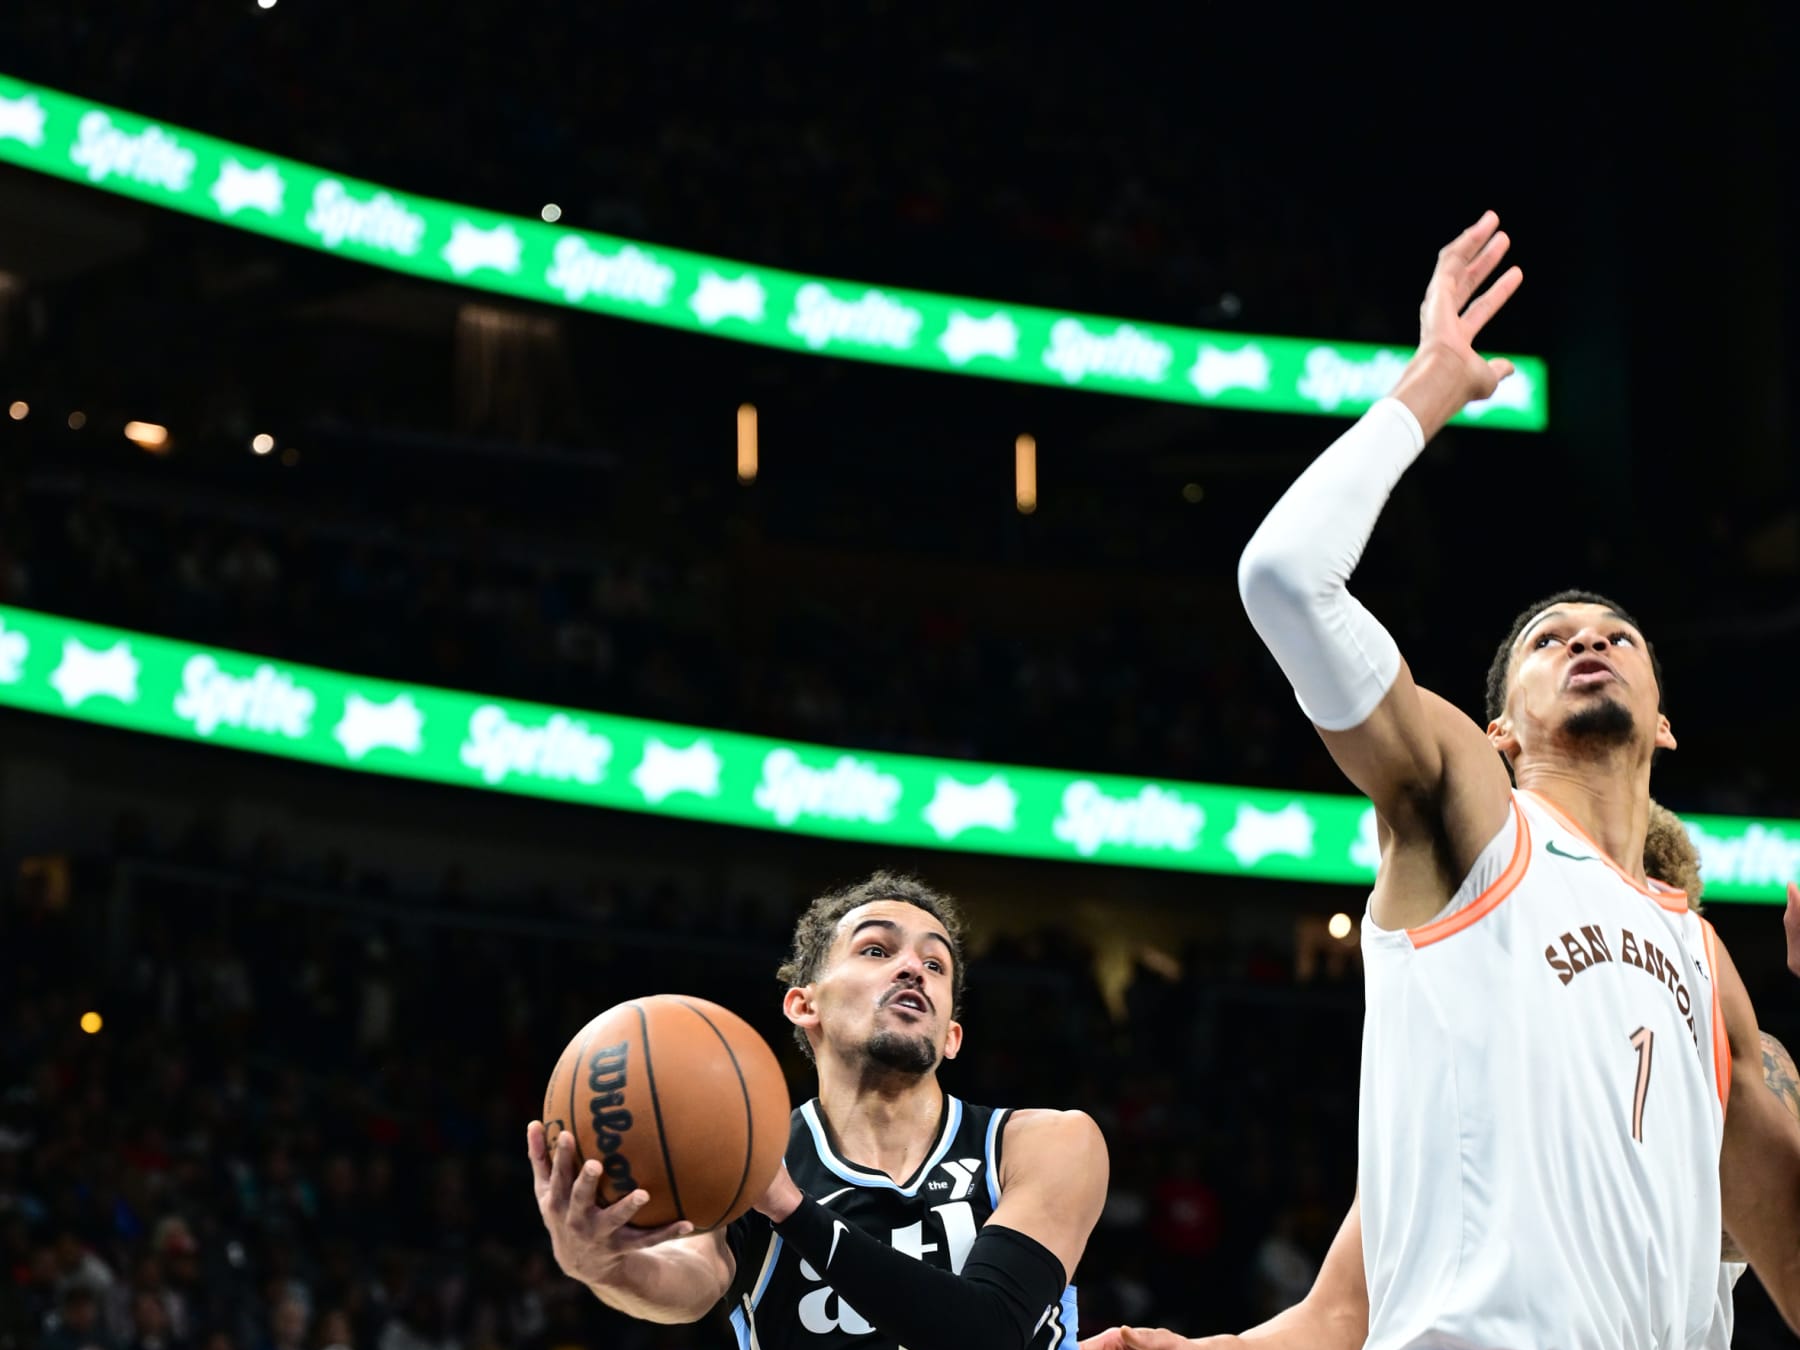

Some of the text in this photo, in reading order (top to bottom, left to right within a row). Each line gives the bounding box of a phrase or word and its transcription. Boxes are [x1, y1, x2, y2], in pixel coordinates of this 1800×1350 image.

[70, 111, 196, 191] Sprite
[305, 179, 425, 255] Sprite
[546, 235, 675, 306] Sprite
[786, 283, 922, 349] Sprite
[1042, 319, 1173, 383] Sprite
[1298, 346, 1408, 410] Spri
[173, 655, 316, 738] Sprite
[460, 705, 612, 784] Sprite
[753, 748, 902, 825] Sprite
[1053, 780, 1205, 856] Sprite
[1545, 924, 1614, 986] SAN
[1629, 1026, 1654, 1143] 1
[928, 1181, 949, 1191] the
